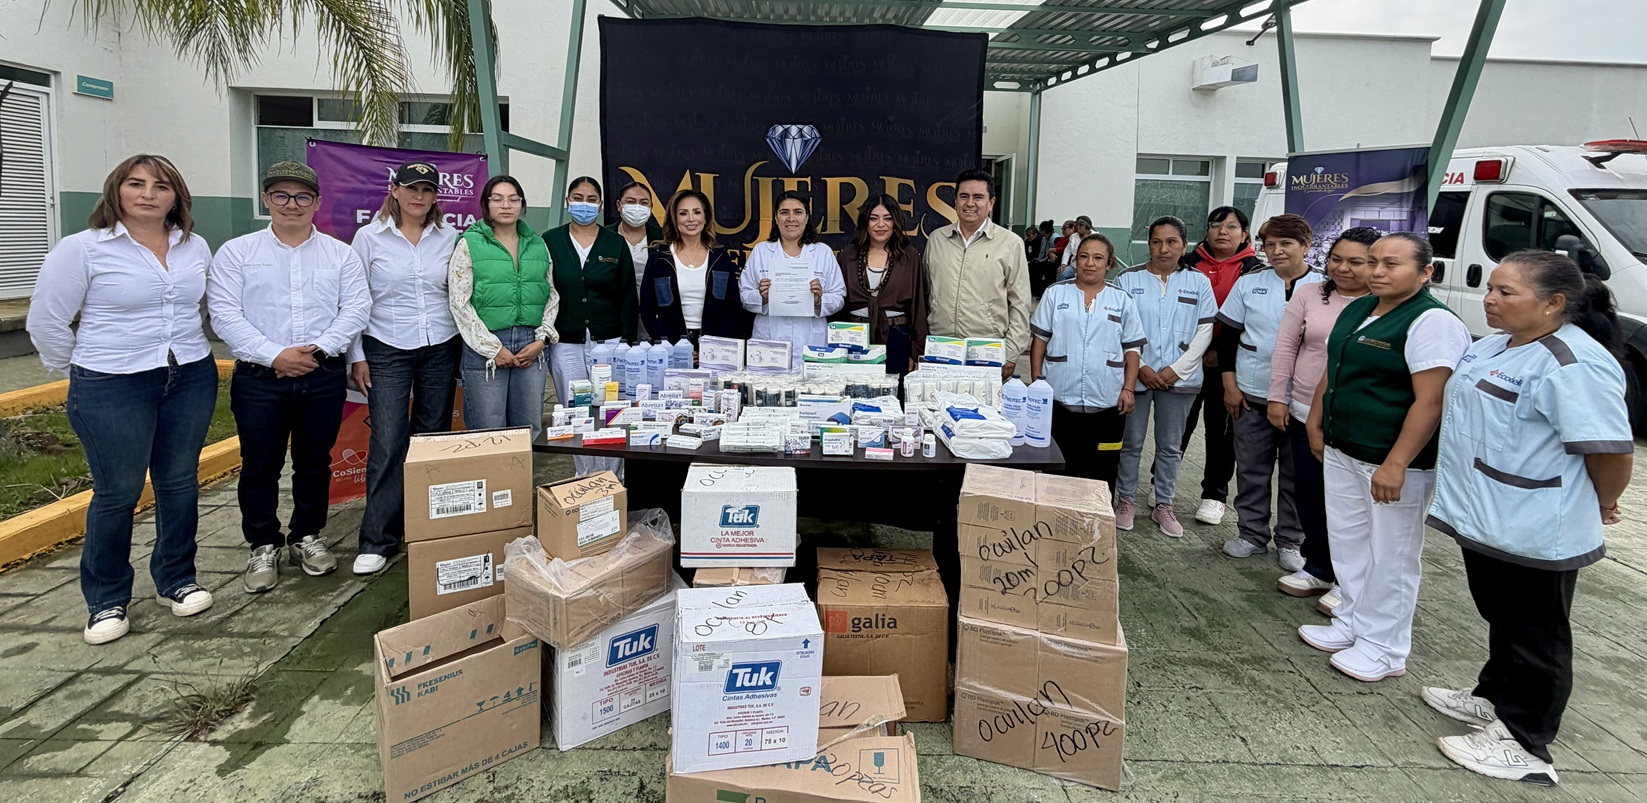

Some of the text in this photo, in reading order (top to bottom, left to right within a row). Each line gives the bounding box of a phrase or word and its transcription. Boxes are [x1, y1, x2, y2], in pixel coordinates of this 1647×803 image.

[386, 166, 474, 189] MRES
[1291, 172, 1349, 186] MUJERES
[618, 160, 958, 248] MUJERES
[725, 507, 755, 524] Tuk
[851, 613, 898, 633] galia
[613, 633, 653, 659] Tuk
[604, 664, 628, 676] INDUSTRIAS
[418, 669, 463, 690] FRESENIUS
[649, 678, 667, 687] MEDIDA
[732, 667, 775, 688] Tuk
[418, 685, 438, 697] KABI
[722, 692, 778, 702] Cintas Adhesivas
[599, 697, 614, 706] TIPO
[600, 705, 614, 715] 1500
[715, 741, 730, 750] 1400
[744, 738, 753, 747] 20
[404, 788, 418, 799] NO
[420, 771, 459, 792] ESTIBAR
[461, 762, 480, 775] MÁS
[481, 757, 493, 766] DE
[501, 741, 528, 757] CAJAS
